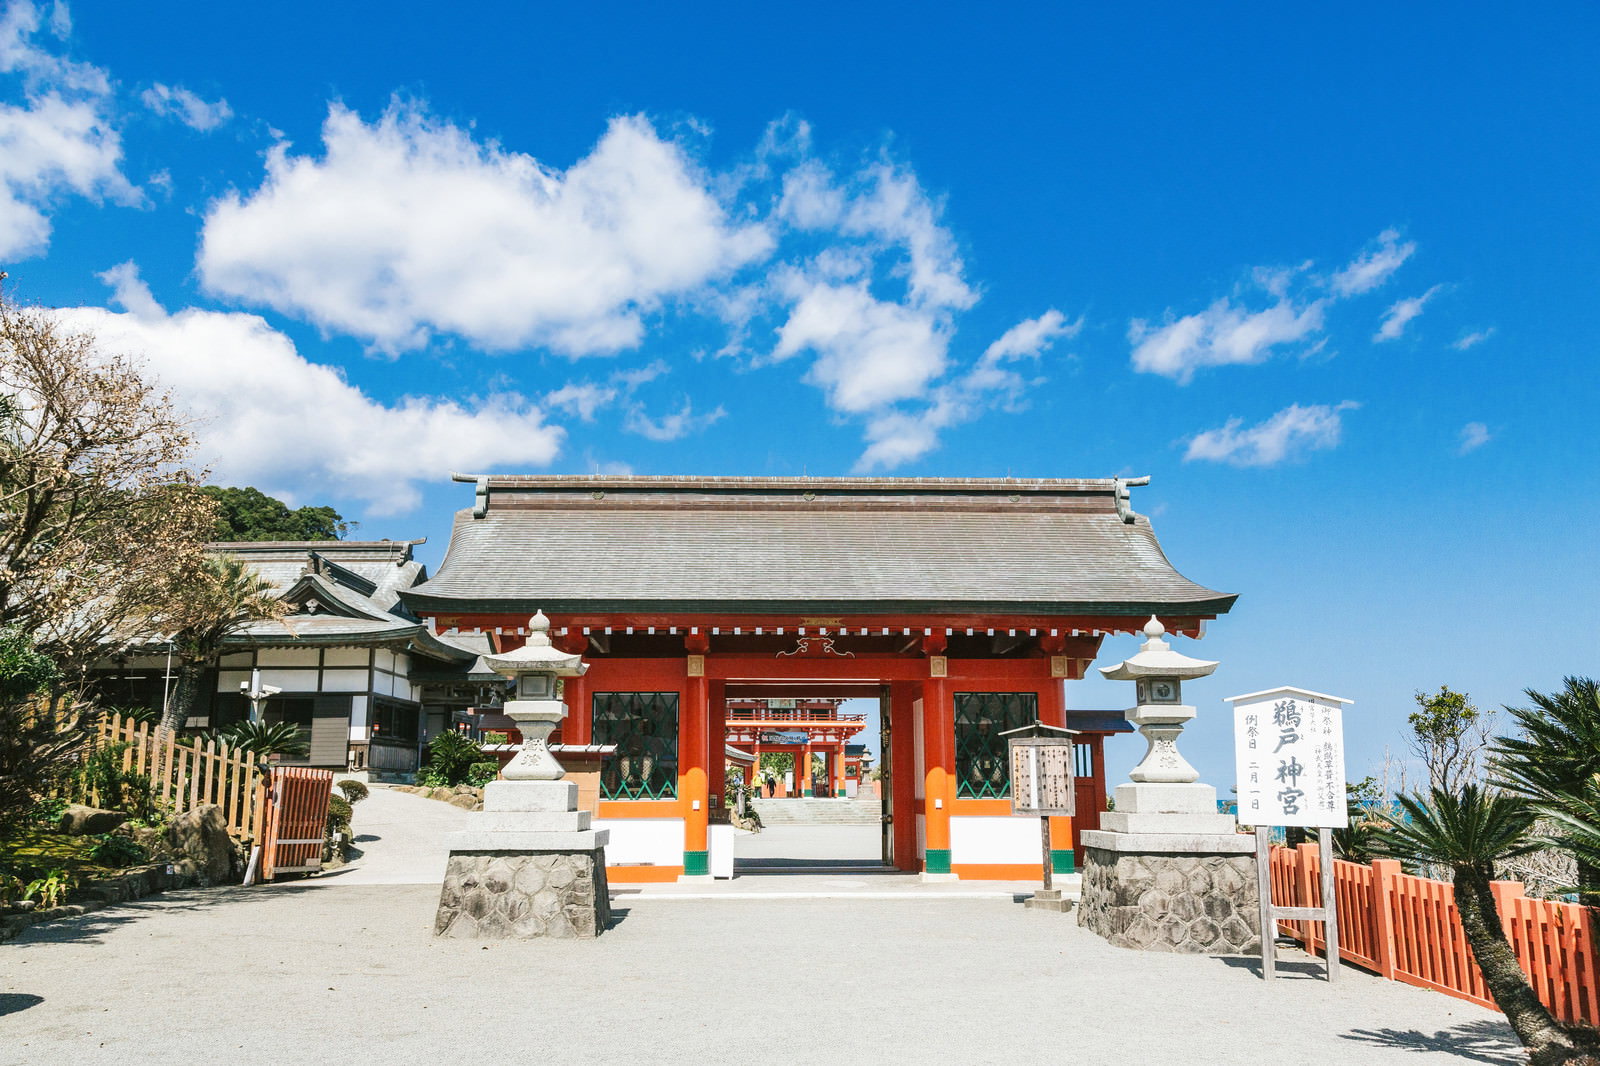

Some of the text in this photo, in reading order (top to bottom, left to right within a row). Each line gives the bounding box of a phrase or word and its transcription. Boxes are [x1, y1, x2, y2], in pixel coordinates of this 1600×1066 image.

[1245, 714, 1260, 810] 例祭日 二月一日
[1272, 700, 1305, 816] 鵜戸神宮
